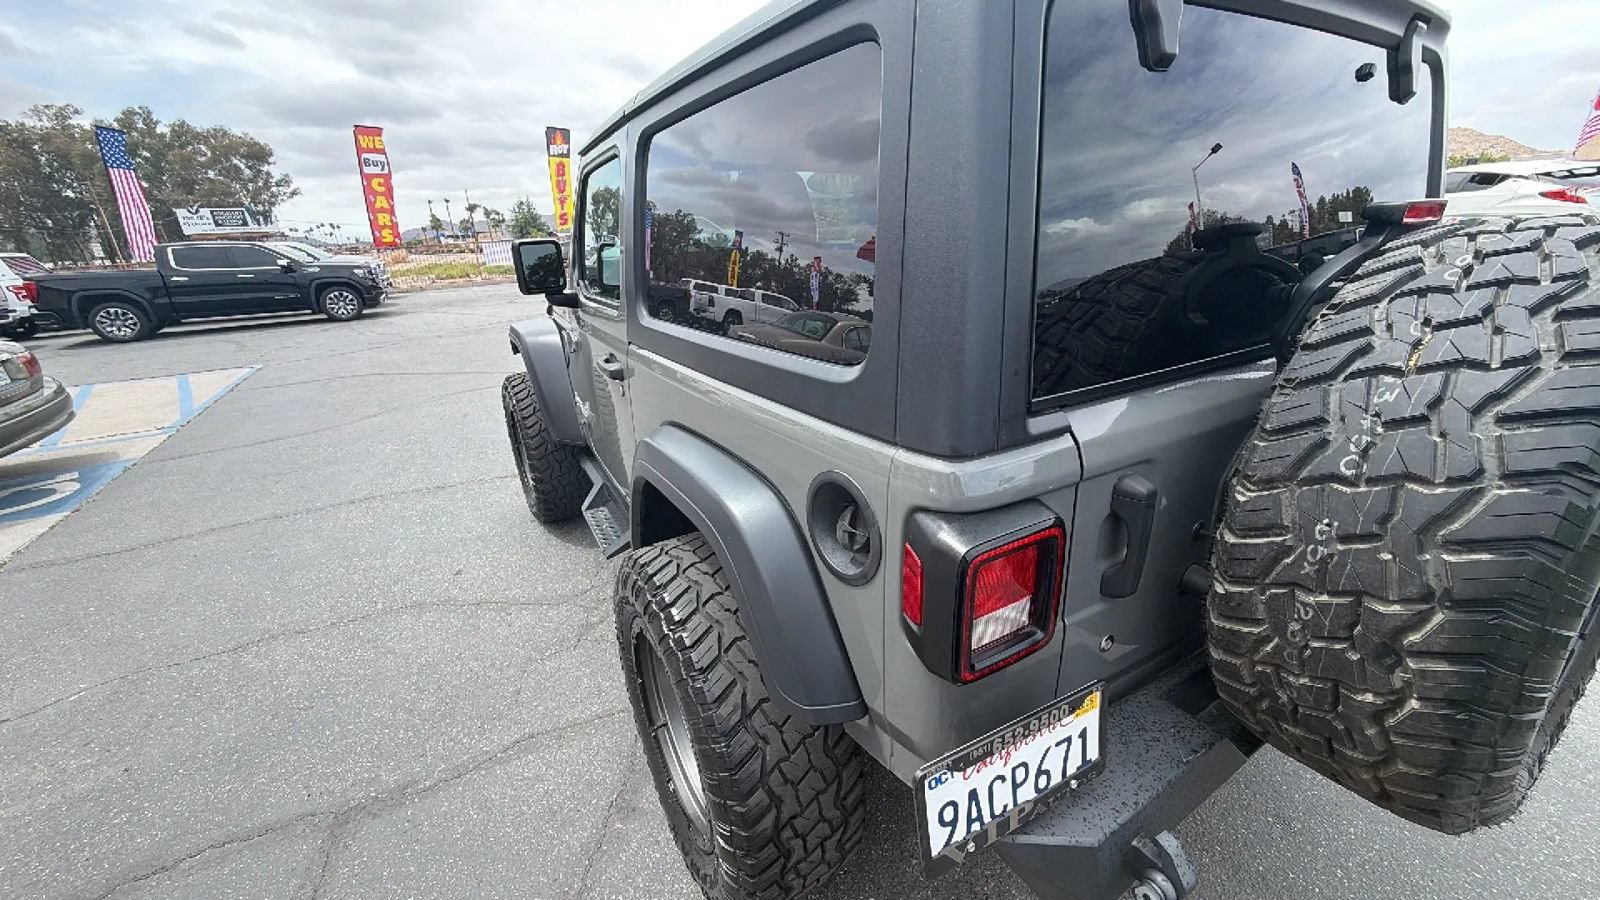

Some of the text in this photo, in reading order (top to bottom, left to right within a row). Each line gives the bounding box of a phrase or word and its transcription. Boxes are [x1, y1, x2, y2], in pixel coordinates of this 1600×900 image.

[358, 134, 385, 150] WE
[549, 144, 569, 156] HOT
[363, 157, 386, 172] Buy
[371, 177, 395, 243] CARS
[937, 726, 1093, 857] 9ACP671
